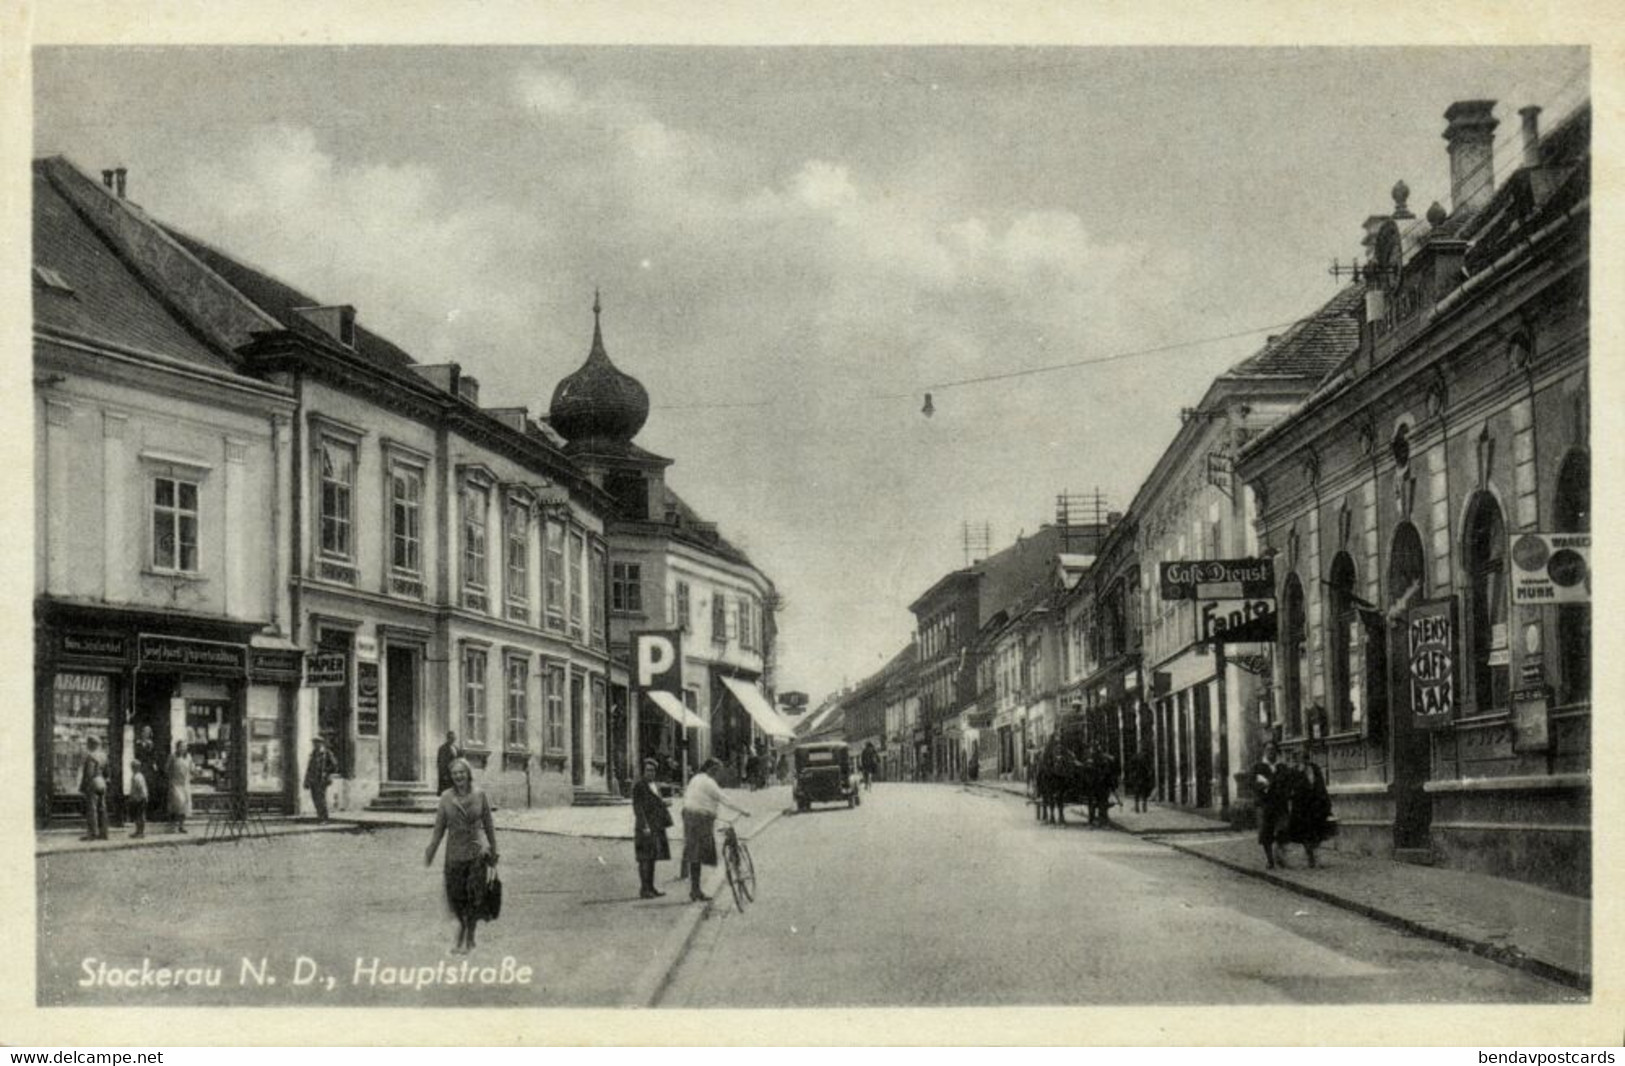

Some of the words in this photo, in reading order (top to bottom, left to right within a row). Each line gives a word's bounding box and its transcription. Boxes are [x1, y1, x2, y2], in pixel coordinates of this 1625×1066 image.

[1206, 561, 1267, 583] Dienst
[1203, 599, 1269, 639] Fanto
[1411, 617, 1451, 657] DIENST
[307, 657, 344, 672] PAPIER
[638, 635, 674, 686] P
[1416, 650, 1448, 680] CAFE
[53, 674, 106, 693] ABADIE
[1414, 680, 1452, 714] BAR
